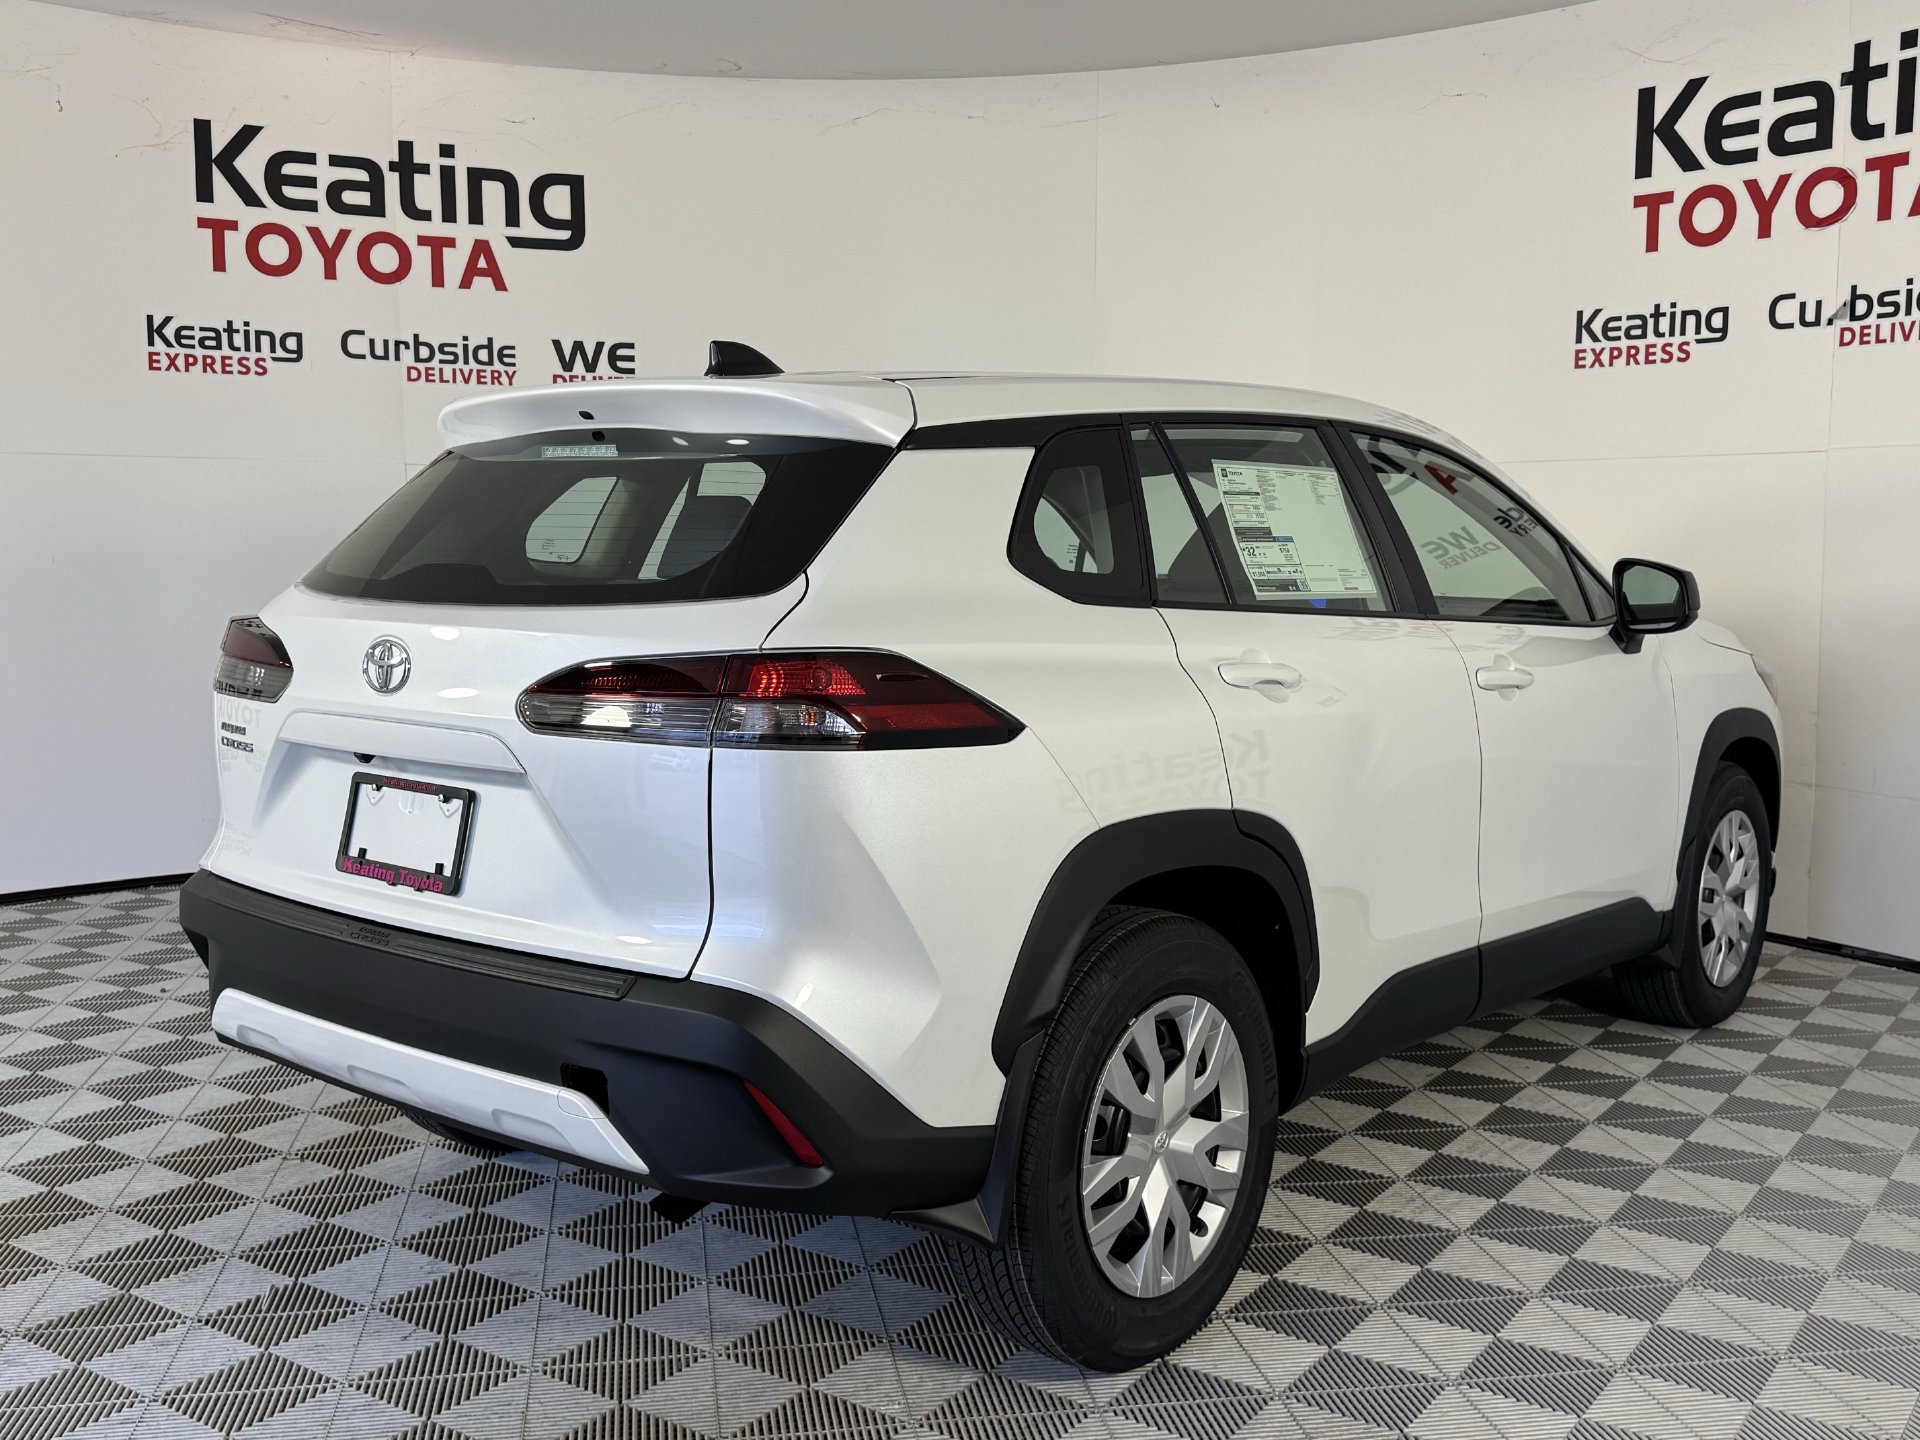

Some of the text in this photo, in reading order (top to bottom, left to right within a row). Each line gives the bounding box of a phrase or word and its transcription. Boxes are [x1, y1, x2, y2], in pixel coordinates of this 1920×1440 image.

[193, 117, 586, 252] Keating
[196, 216, 508, 292] TOYOTA
[1575, 277, 1920, 344] Keating Cubsi
[146, 314, 636, 375] Keating Curbside WE
[1839, 317, 1920, 348] DELIV
[147, 352, 268, 377] EXPRESS
[1574, 341, 1691, 369] EXPRESS
[405, 365, 517, 386] DELIVERY
[343, 857, 443, 893] Keating Toyota
